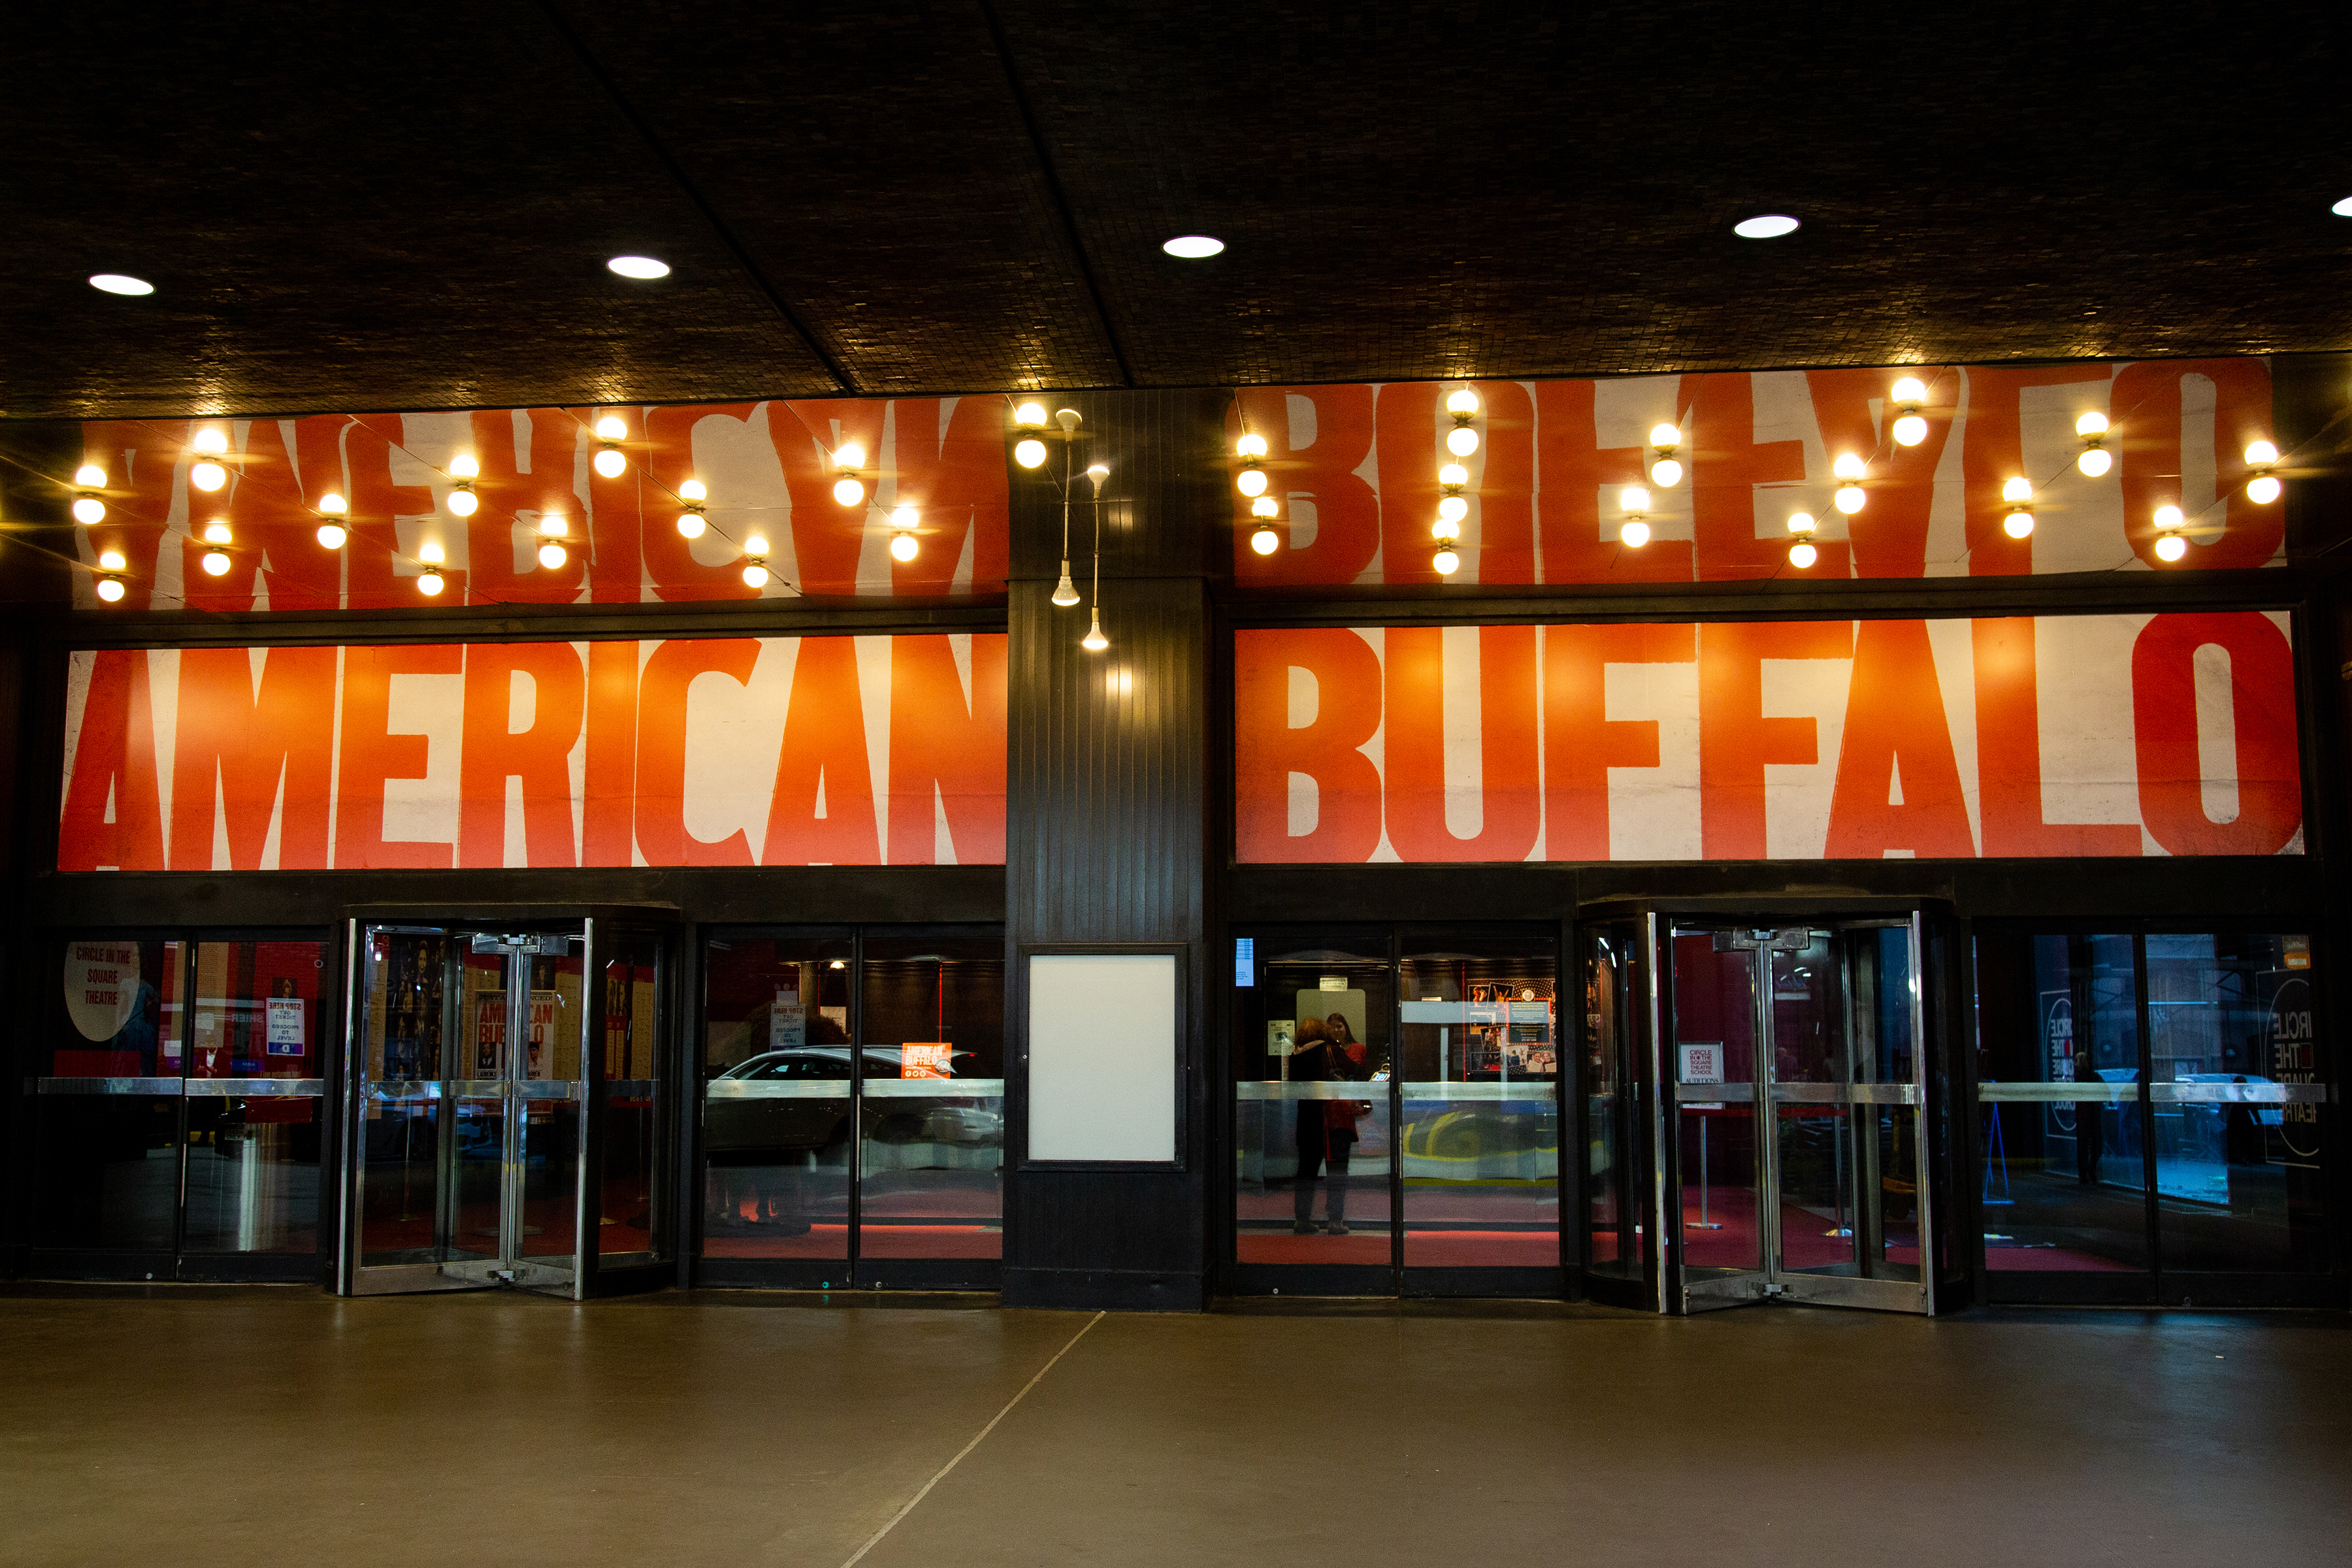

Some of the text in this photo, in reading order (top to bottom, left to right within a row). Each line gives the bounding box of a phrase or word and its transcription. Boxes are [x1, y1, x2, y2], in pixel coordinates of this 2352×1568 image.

[58, 612, 2302, 871] AMERICAN BUFFALO
[76, 946, 131, 964] CIRCLE IN THE
[88, 968, 118, 984] SQUARE
[86, 990, 118, 1005] THEATRE
[906, 1045, 943, 1056] AMERICAN
[905, 1055, 938, 1066] BUFFALO
